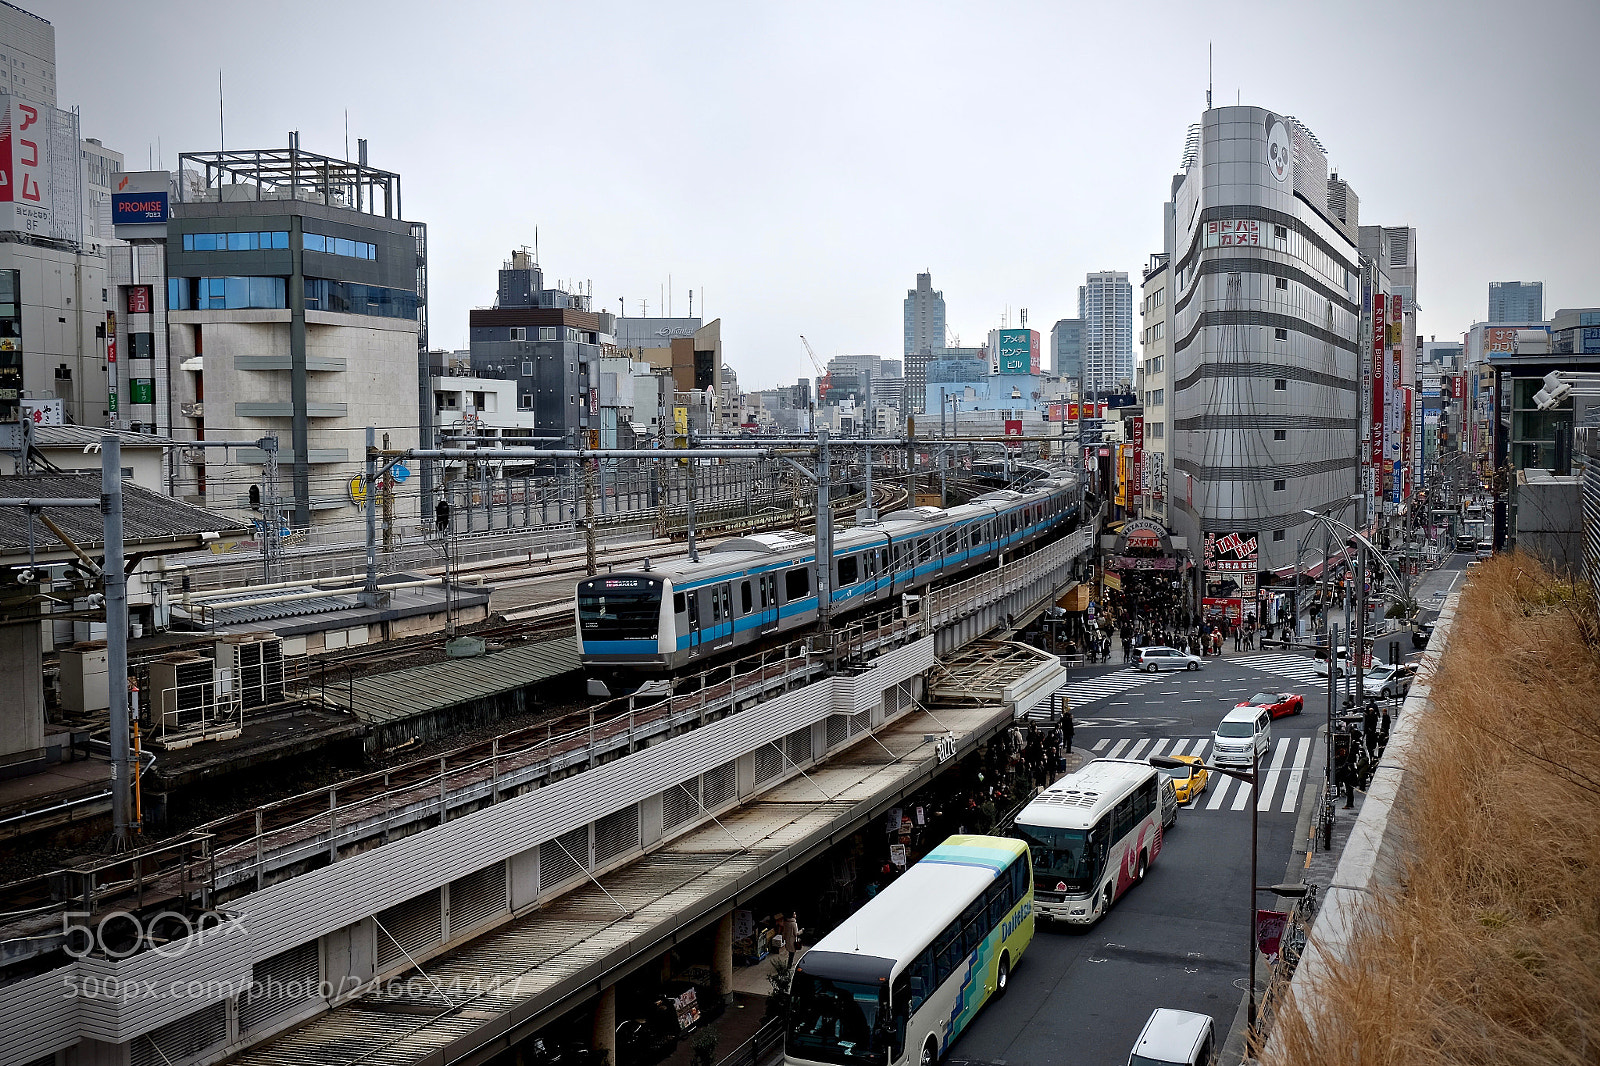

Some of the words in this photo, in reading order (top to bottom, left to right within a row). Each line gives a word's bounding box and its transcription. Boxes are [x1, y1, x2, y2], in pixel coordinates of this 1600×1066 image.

[19, 104, 40, 201] アコム
[118, 201, 161, 212] PROMISE
[26, 219, 38, 230] 8F
[1209, 221, 1258, 234] ヨドバシ
[1221, 234, 1258, 246] カメラ
[137, 288, 145, 310] アコム
[1375, 308, 1383, 341] カラオケ
[1495, 330, 1515, 341] サウ
[1001, 348, 1029, 356] センター
[1007, 361, 1022, 369] ビル
[1373, 422, 1382, 455] カラオケ
[1128, 538, 1159, 547] アメヤ横丁
[1216, 532, 1243, 554] TAX
[1234, 537, 1257, 559] FREE
